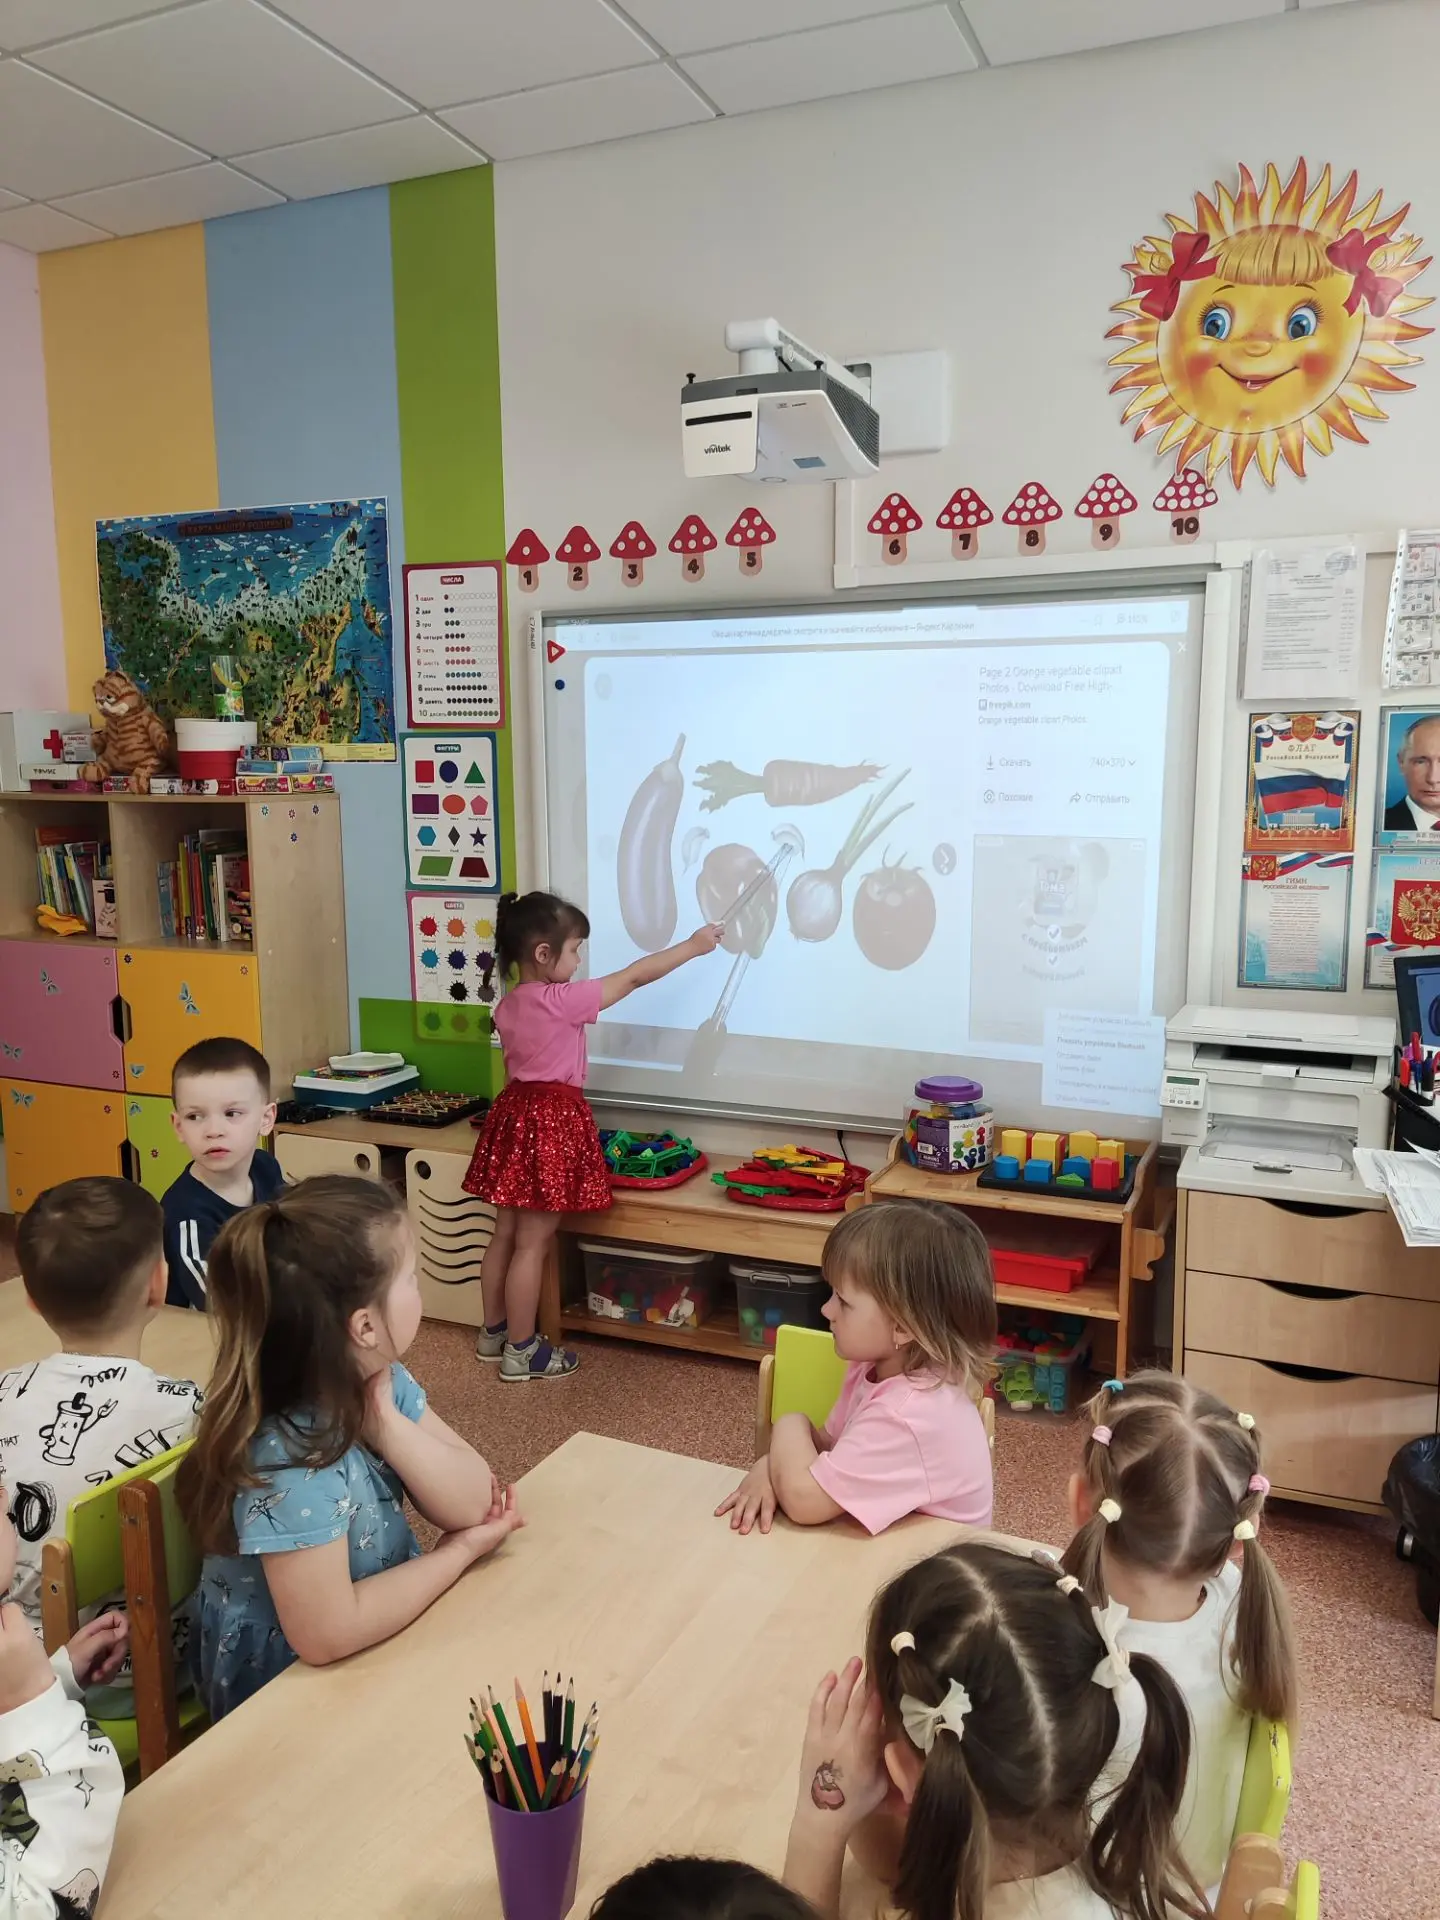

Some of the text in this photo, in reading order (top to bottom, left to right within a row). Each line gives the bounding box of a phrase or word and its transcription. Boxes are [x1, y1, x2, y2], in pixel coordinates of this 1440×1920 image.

[704, 444, 731, 455] vivitek
[1099, 523, 1113, 542] 9
[1172, 516, 1199, 536] 10
[959, 533, 971, 550] 7
[1026, 530, 1039, 547] 8
[889, 539, 900, 556] 6
[688, 558, 699, 574] 4
[746, 551, 756, 568] 5
[523, 571, 531, 586] 1
[573, 566, 583, 582] 2
[628, 564, 638, 580] 3
[979, 667, 1002, 679] Page
[1005, 667, 1011, 677] 2
[1013, 666, 1045, 679] Orange
[1047, 665, 1091, 678] vegetable
[979, 682, 1009, 693] Photos
[1017, 681, 1062, 692] Download
[1064, 680, 1085, 691] Free
[989, 701, 1031, 710] freepik.com
[1004, 715, 1038, 725] vegetable
[1288, 743, 1317, 752] ФЛАГ
[999, 757, 1032, 767] Скачать
[998, 792, 1130, 804] Похожие Отправить
[157, 1383, 190, 1396] STYLE
